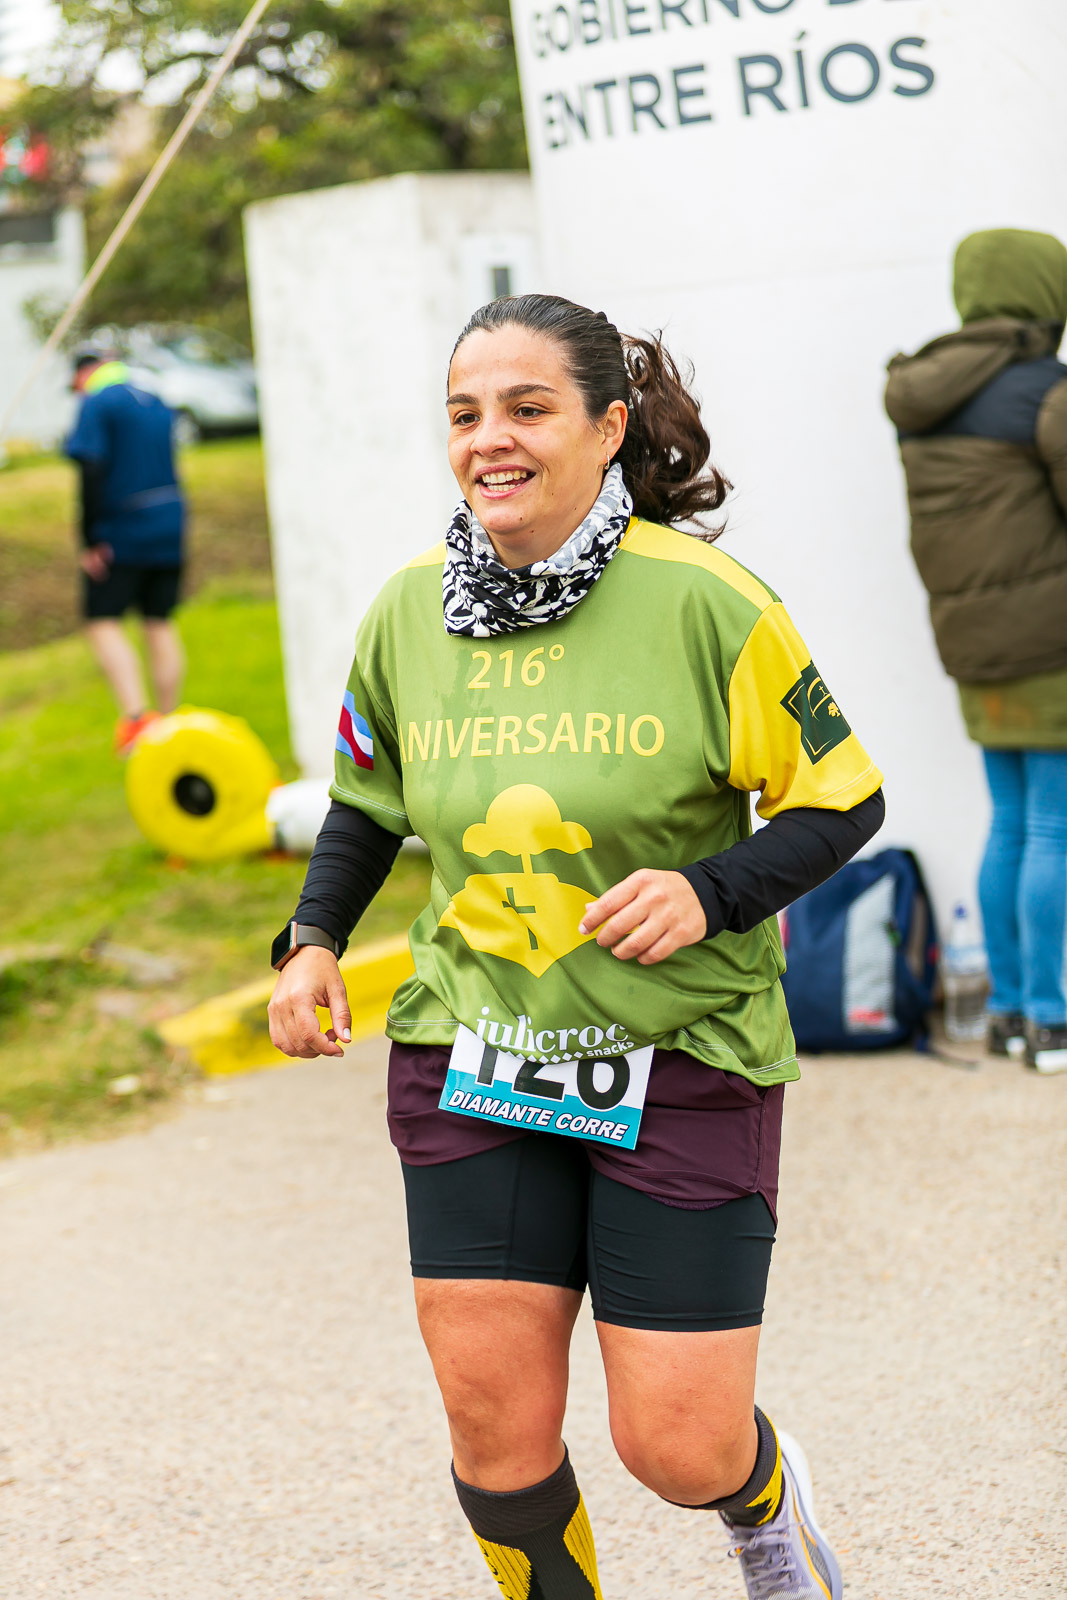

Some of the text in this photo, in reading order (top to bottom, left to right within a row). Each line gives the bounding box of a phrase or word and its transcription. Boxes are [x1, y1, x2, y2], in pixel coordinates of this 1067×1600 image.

[532, 0, 796, 58] GOBIER
[544, 30, 935, 149] ENTRE RÍOS
[586, 1041, 635, 1058] snacks
[447, 1089, 630, 1142] DIAMANTE CORRE
